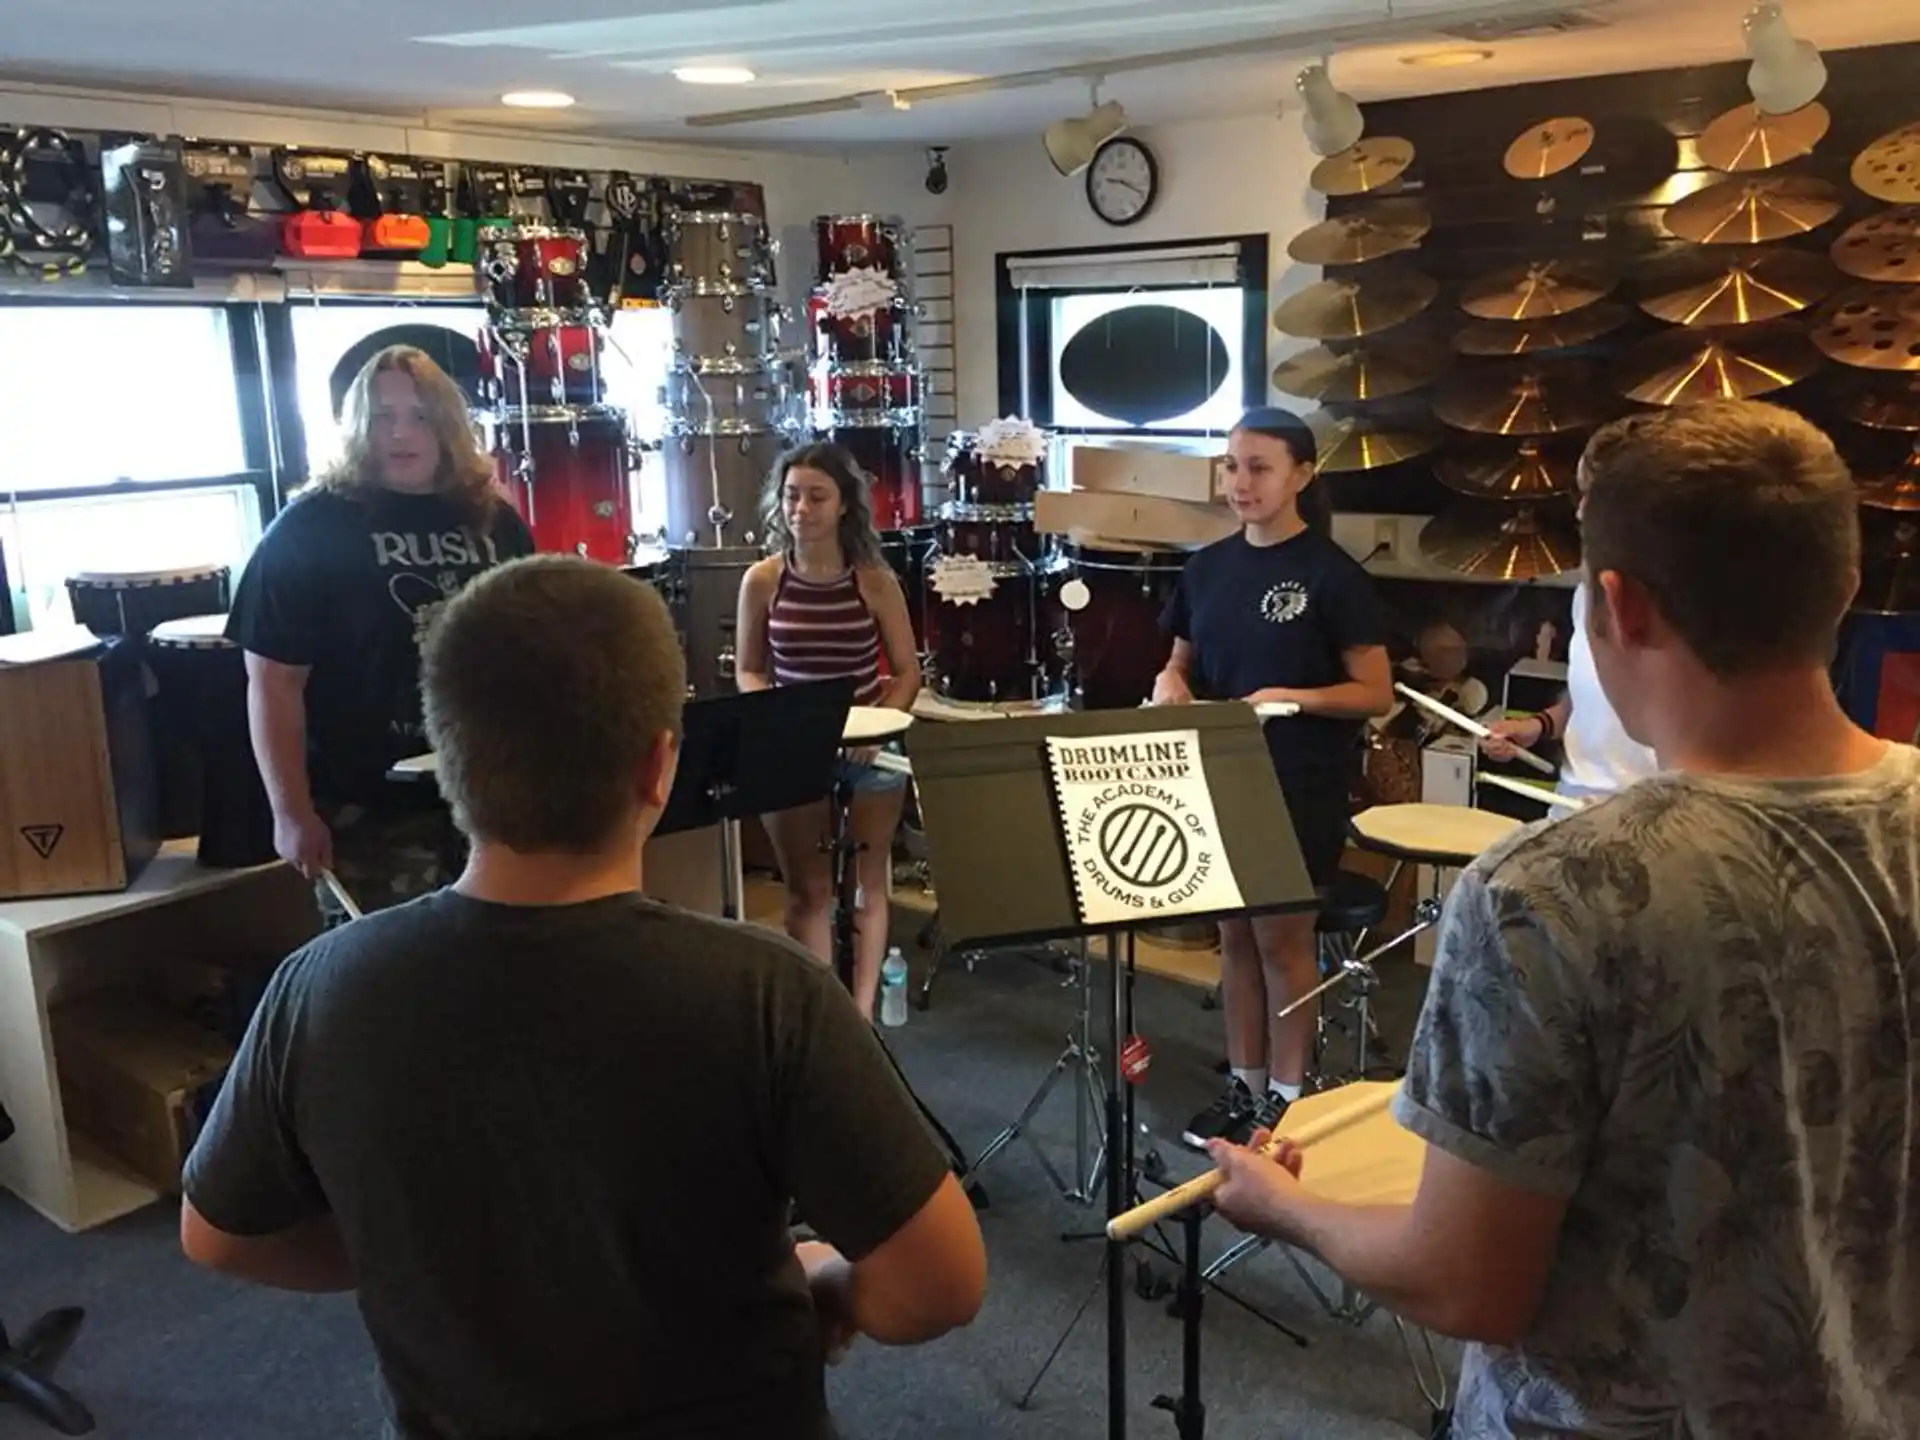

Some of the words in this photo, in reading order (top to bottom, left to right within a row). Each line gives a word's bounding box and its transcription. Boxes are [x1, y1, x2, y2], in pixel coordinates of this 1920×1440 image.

[1059, 741, 1189, 766] DRUMLINE
[1063, 763, 1191, 782] BOOTCAMP
[1077, 807, 1097, 845] THE
[1094, 783, 1186, 811] ACADEMY
[1184, 813, 1207, 838] OF
[1082, 859, 1145, 909] DRUMS
[1149, 896, 1165, 909] &
[1167, 851, 1212, 905] GUITAR
